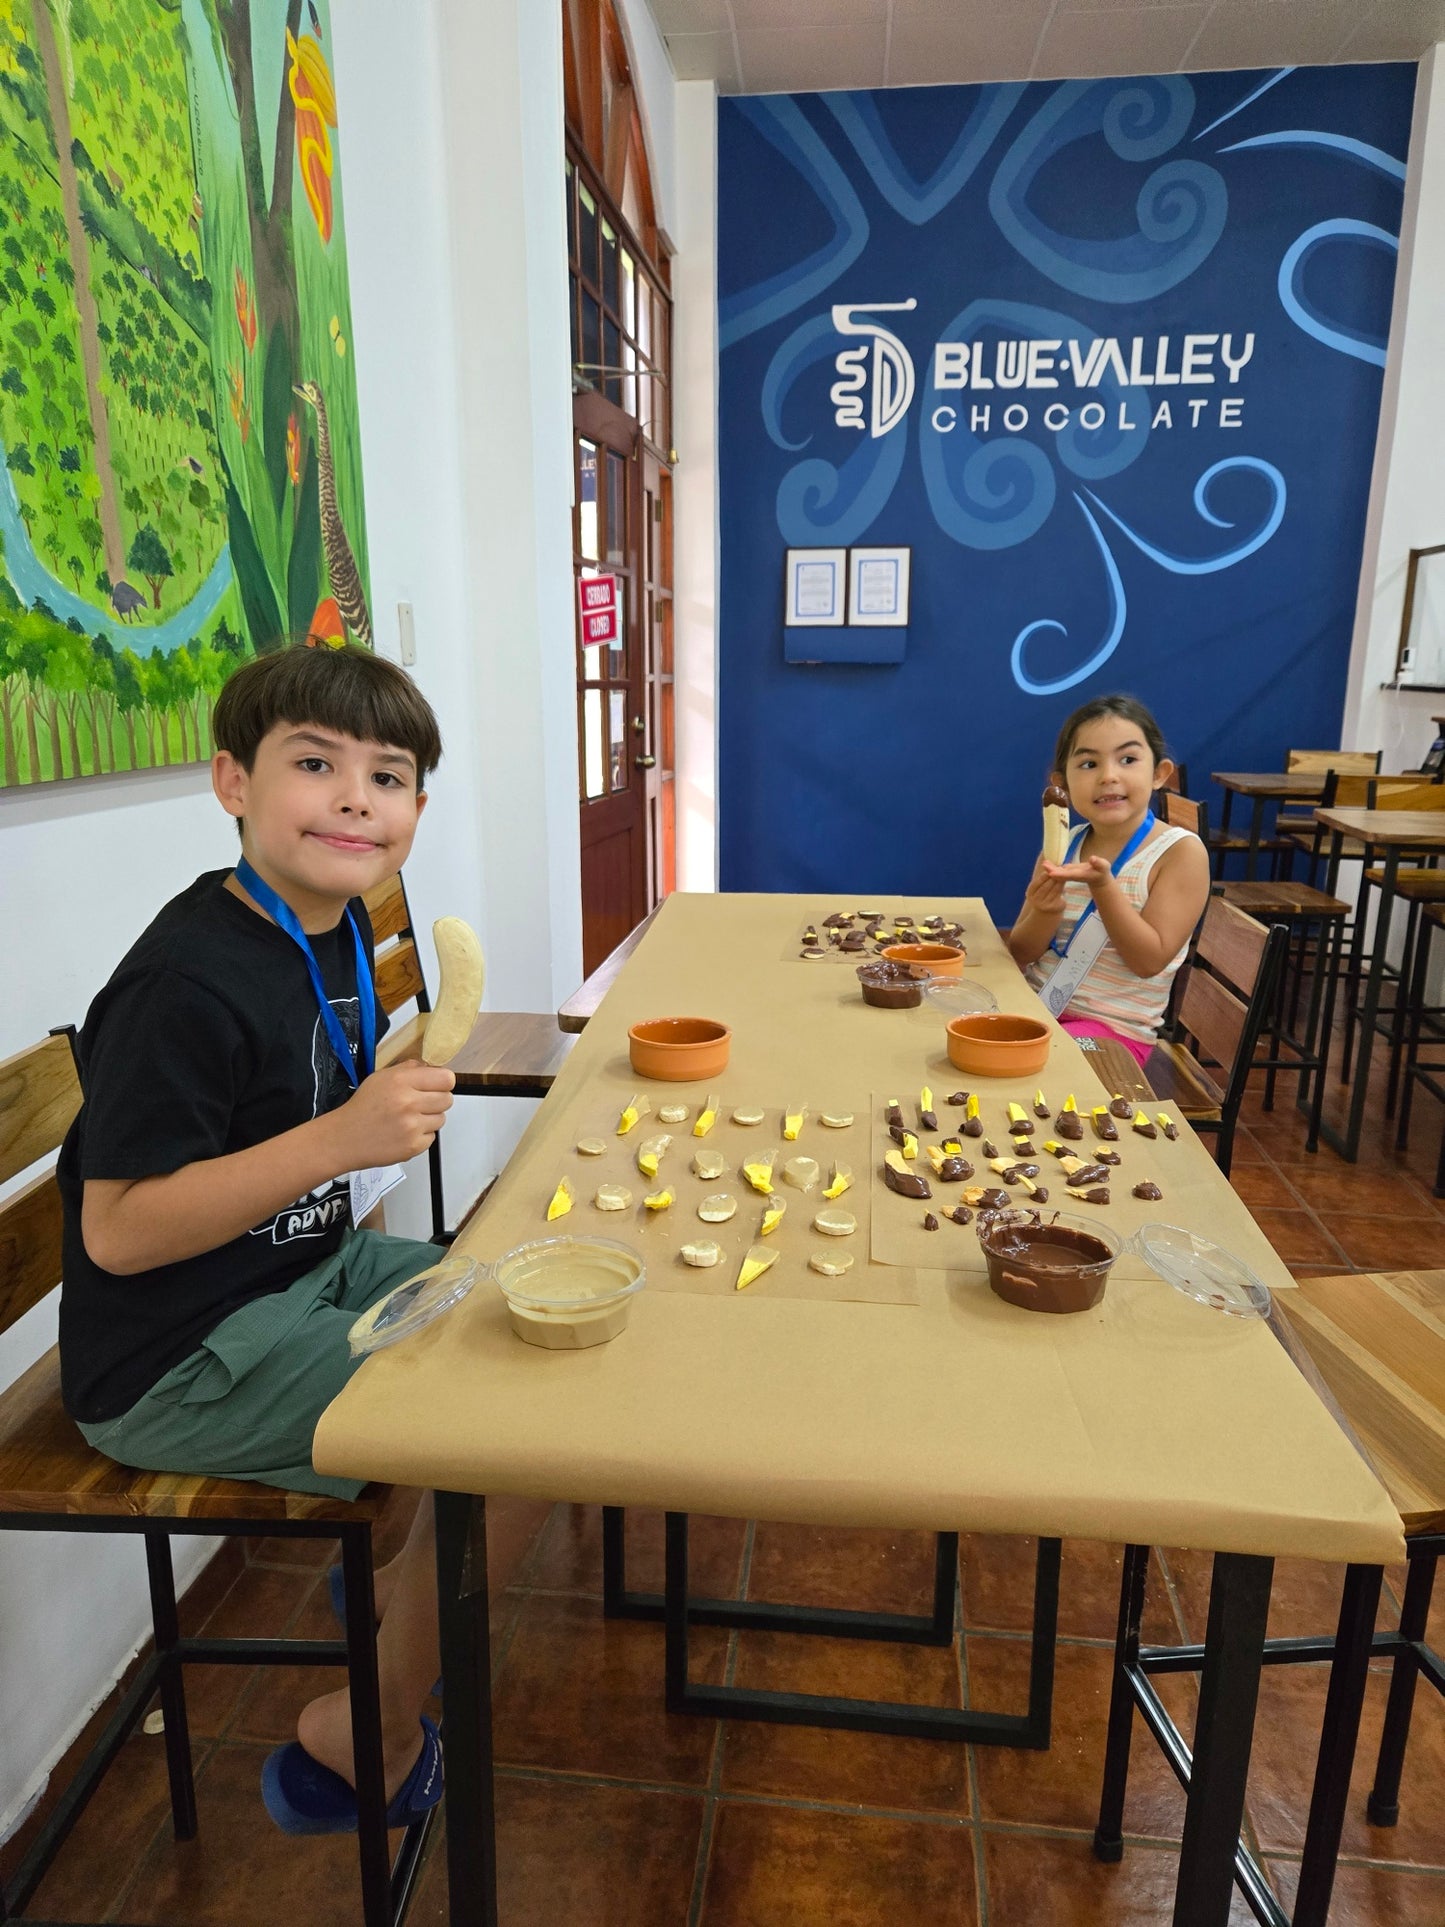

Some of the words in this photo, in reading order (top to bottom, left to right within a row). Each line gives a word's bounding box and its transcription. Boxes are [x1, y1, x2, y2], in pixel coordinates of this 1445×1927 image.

[932, 398, 1245, 433] CHOCOLATE
[586, 584, 611, 607] CERRADO
[589, 615, 610, 637] CLOSED
[287, 1197, 346, 1237] ADVE
